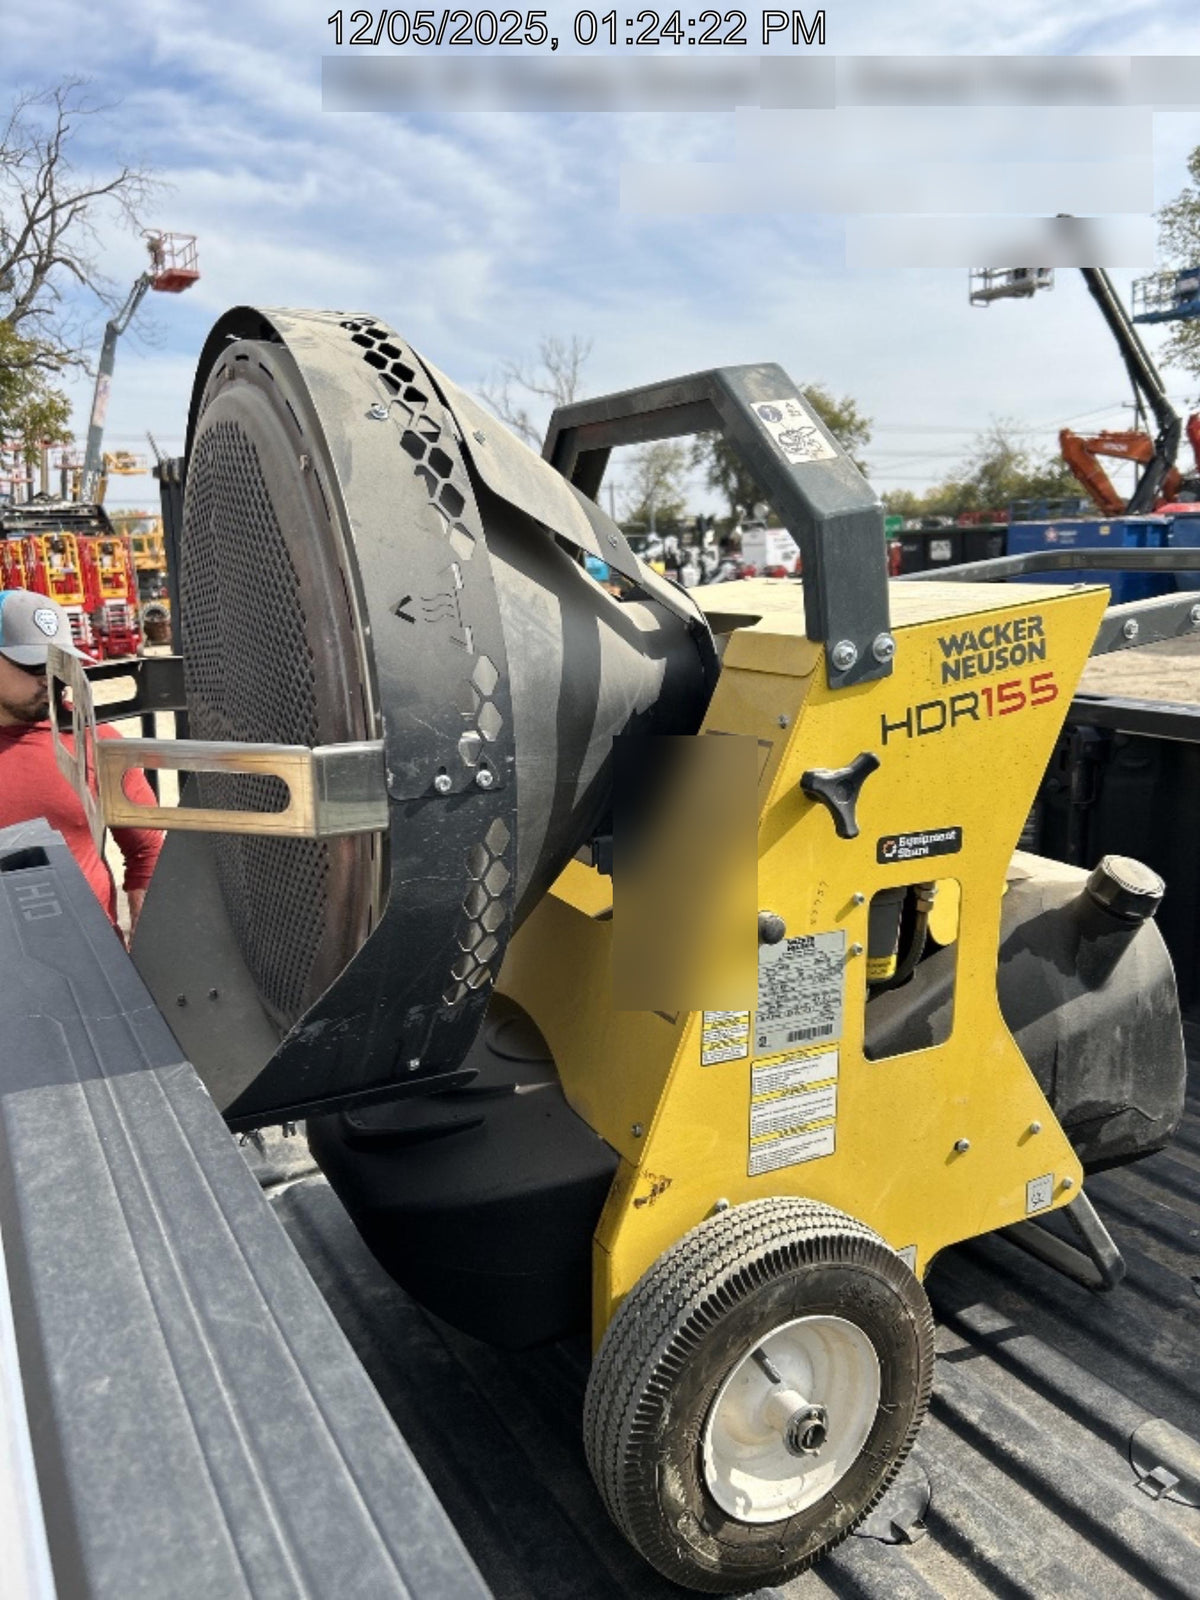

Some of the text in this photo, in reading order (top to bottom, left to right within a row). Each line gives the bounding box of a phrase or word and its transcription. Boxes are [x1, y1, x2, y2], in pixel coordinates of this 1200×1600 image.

[937, 615, 1046, 658] WACKER
[941, 638, 1047, 685] NEUSON
[880, 672, 1059, 745] HDR155
